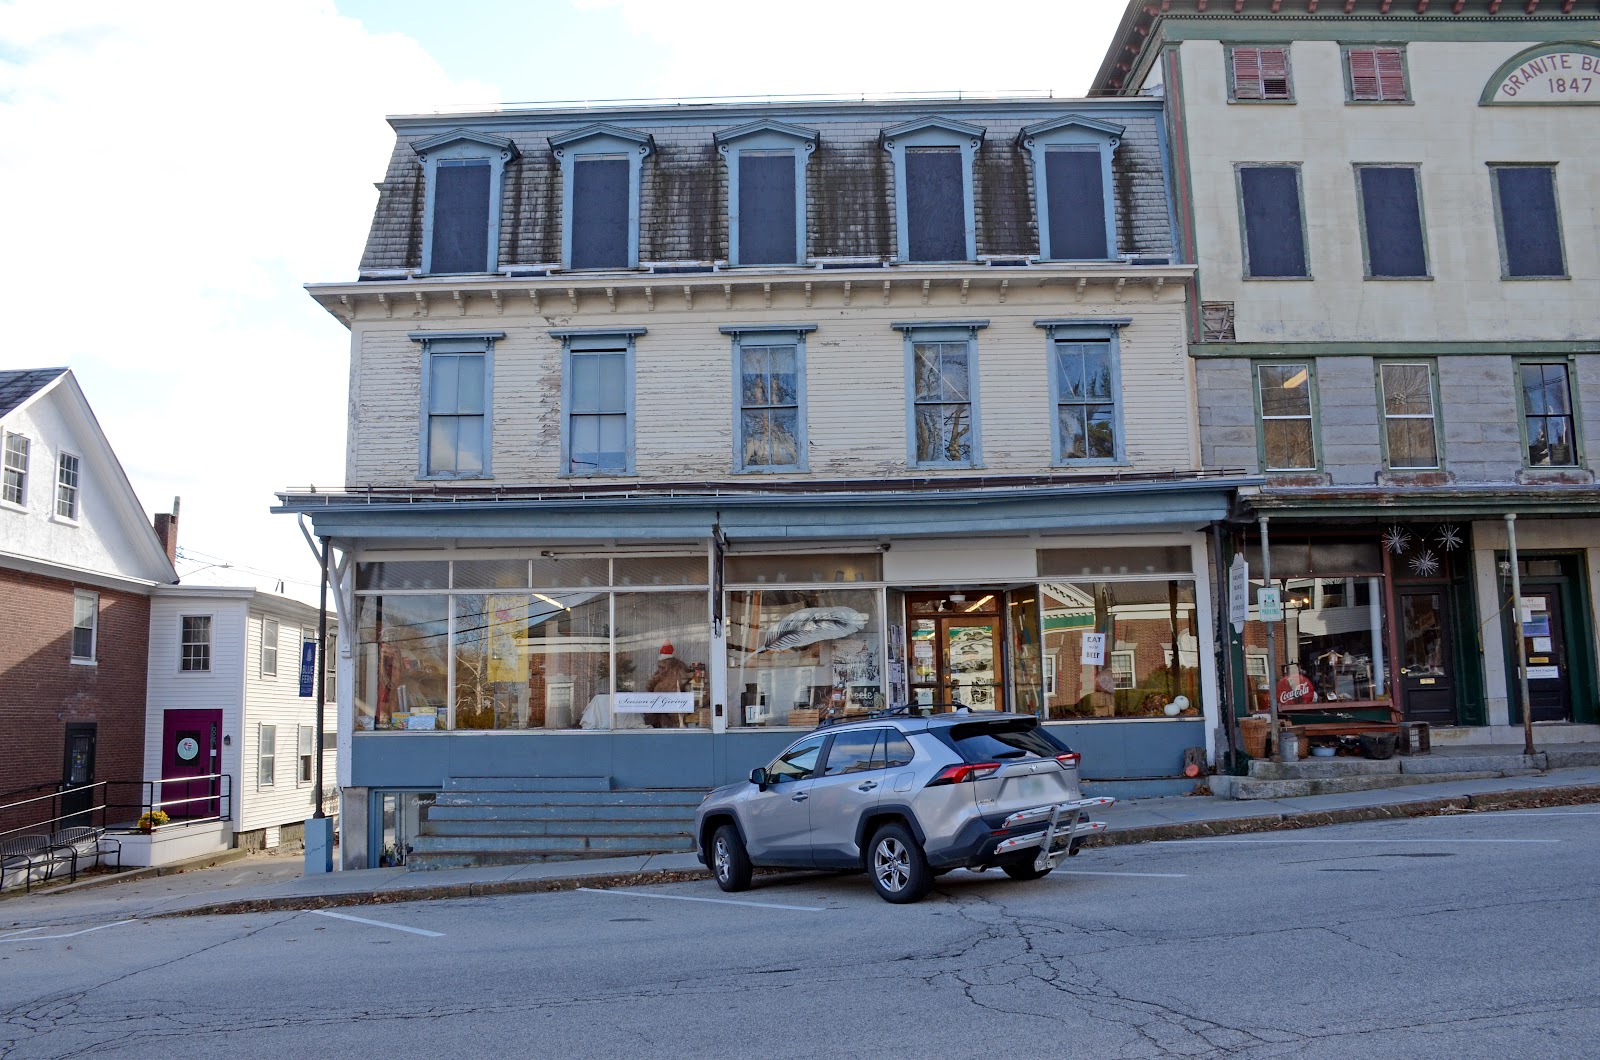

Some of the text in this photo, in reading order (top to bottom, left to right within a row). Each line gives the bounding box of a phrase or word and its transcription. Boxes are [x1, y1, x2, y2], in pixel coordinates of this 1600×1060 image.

[1502, 54, 1571, 97] GRANITE
[1548, 77, 1592, 93] 1847
[302, 665, 314, 674] BLUE
[301, 675, 313, 684] FERN
[618, 695, 688, 709] Season of Giving
[411, 797, 435, 808] Open
